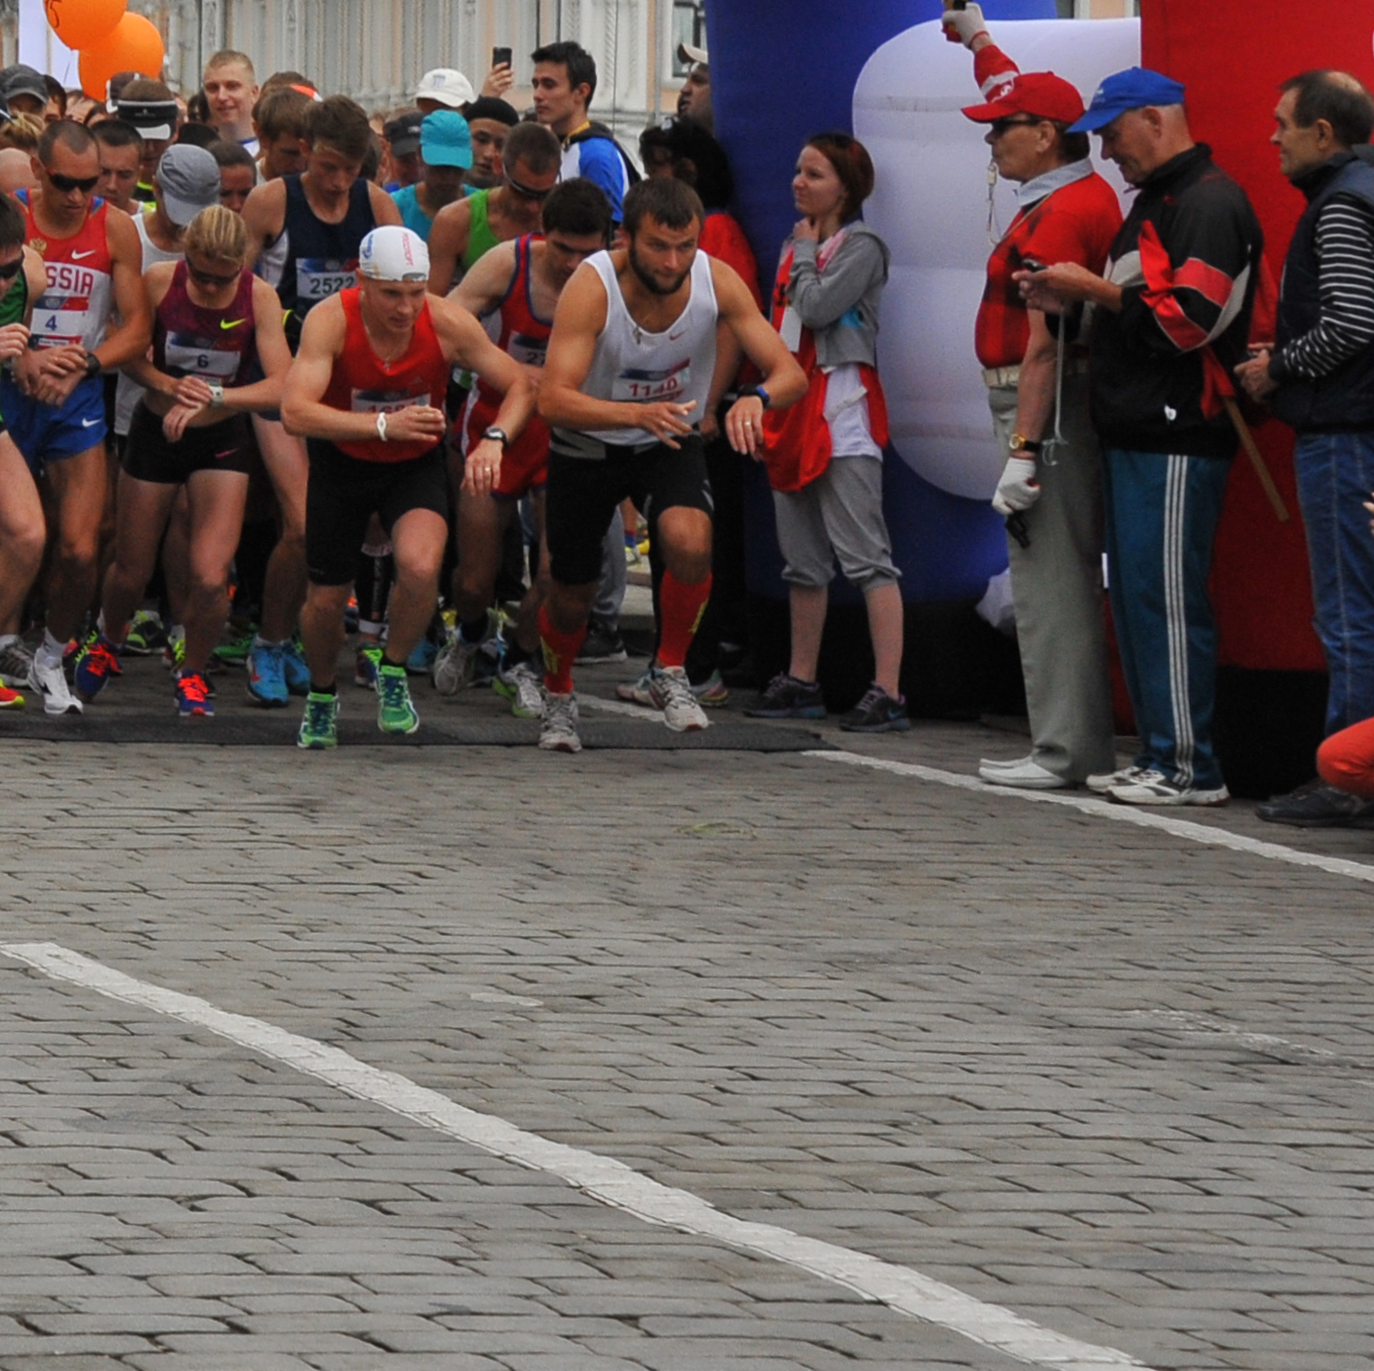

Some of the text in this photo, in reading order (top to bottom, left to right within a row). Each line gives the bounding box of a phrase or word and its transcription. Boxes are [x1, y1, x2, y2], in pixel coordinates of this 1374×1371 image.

[46, 265, 94, 296] SSIA
[309, 276, 354, 295] 2522
[44, 314, 58, 331] 4
[196, 354, 209, 369] 6
